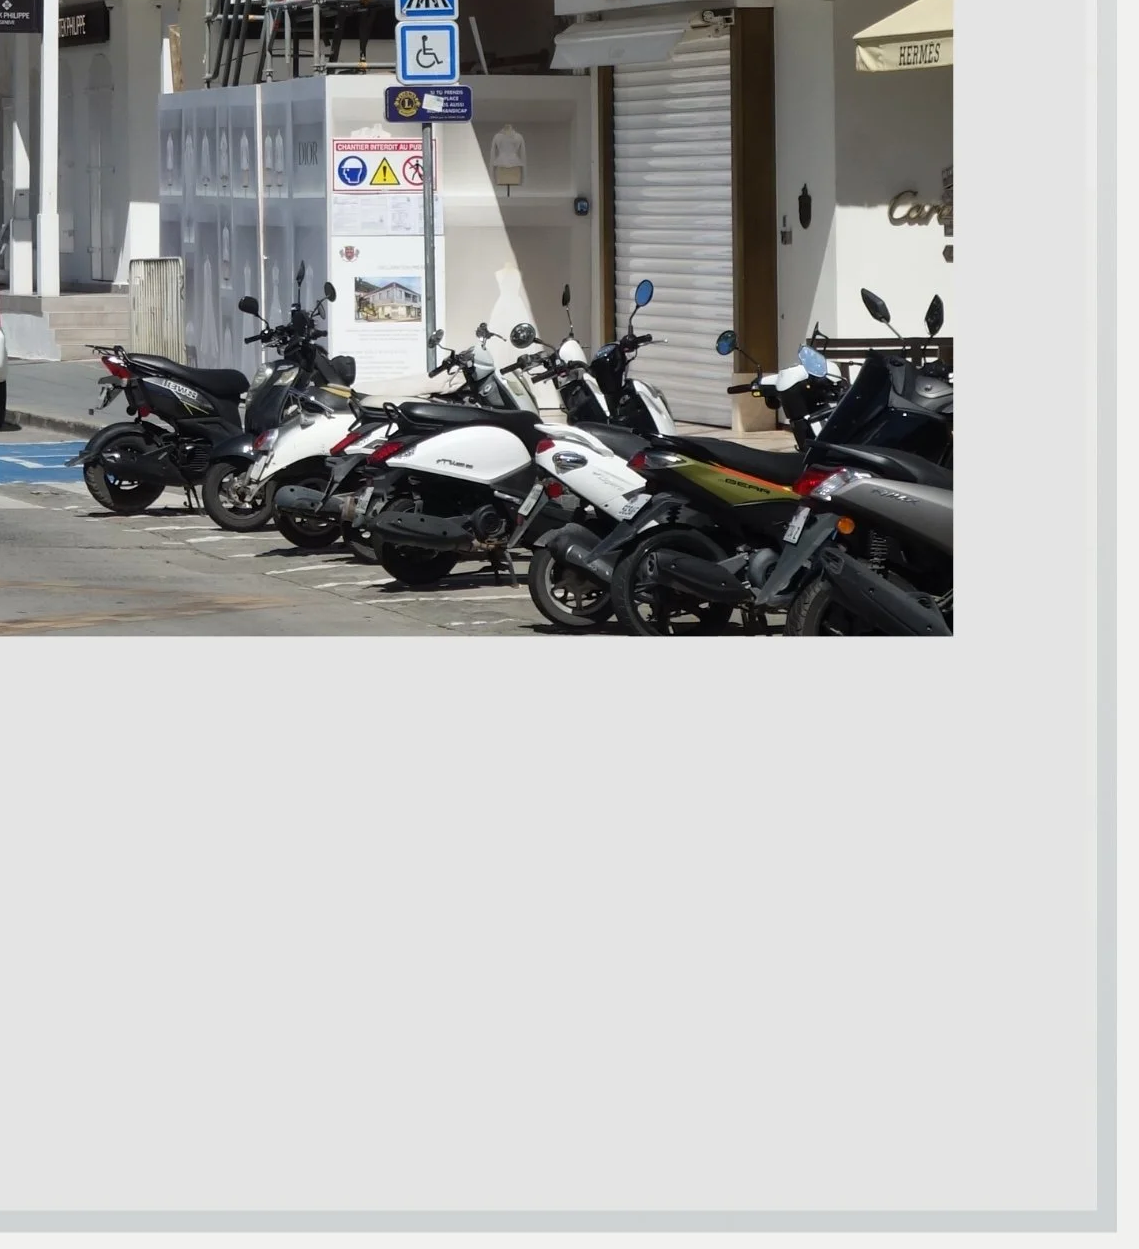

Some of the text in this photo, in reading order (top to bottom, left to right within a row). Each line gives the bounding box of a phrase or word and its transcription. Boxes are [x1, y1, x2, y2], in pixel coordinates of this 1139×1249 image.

[404, 98, 412, 109] L
[337, 143, 422, 151] CHANTIER INTERDIT AU PUB
[298, 141, 318, 166] DIOR
